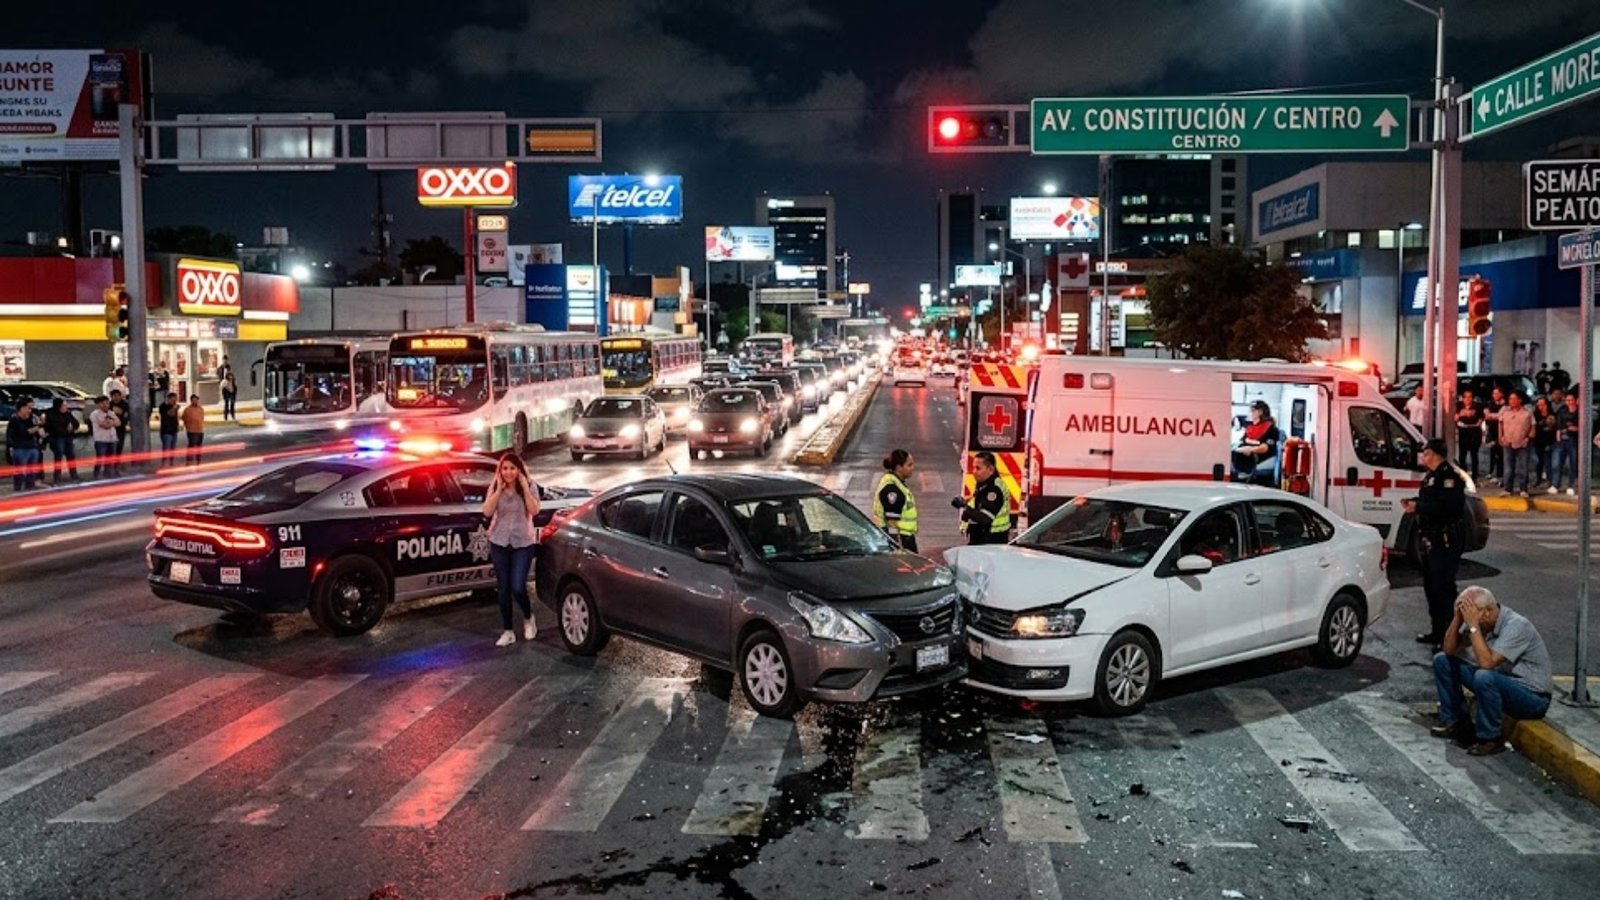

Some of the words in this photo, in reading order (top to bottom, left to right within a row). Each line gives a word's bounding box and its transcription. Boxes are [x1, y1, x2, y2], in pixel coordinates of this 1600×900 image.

[1494, 70, 1544, 117] CALLE
[1551, 46, 1600, 97] MORE
[1041, 109, 1075, 131] AV.
[1084, 102, 1247, 131] CONSTITUCIÓN
[1252, 107, 1267, 130] /
[1274, 106, 1362, 130] CENTRO
[1171, 134, 1241, 149] CENTRO
[421, 167, 511, 199] OXXO
[1535, 196, 1600, 221] PEATO
[181, 269, 239, 305] OXXO
[1065, 413, 1217, 437] AMBULANCIA
[277, 523, 302, 542] 911
[397, 529, 464, 561] POLICÍA
[426, 568, 484, 586] FUERZA
